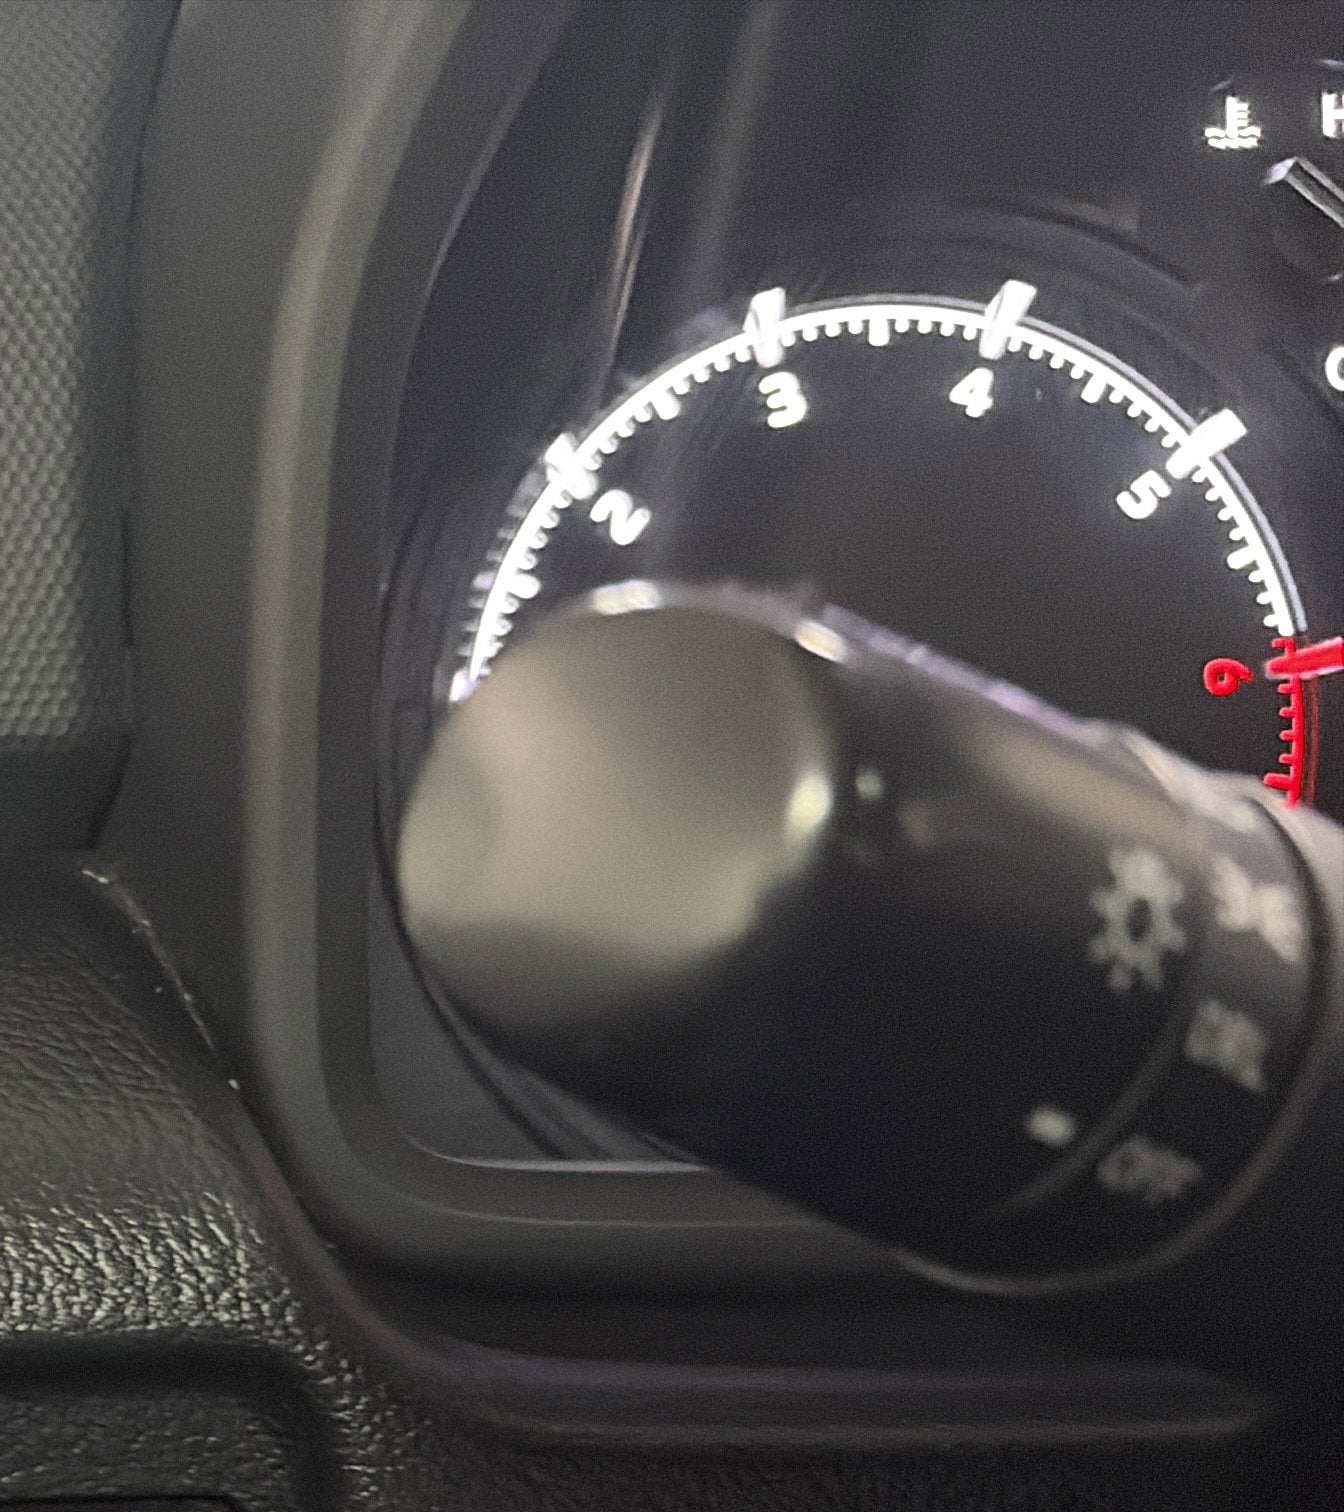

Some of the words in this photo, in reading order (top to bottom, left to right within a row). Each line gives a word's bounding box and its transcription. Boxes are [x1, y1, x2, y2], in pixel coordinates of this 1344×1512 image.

[758, 370, 809, 429] 3
[948, 367, 994, 418] 4
[590, 489, 651, 546] 2
[1115, 470, 1172, 520] 5
[1202, 657, 1254, 697] 6
